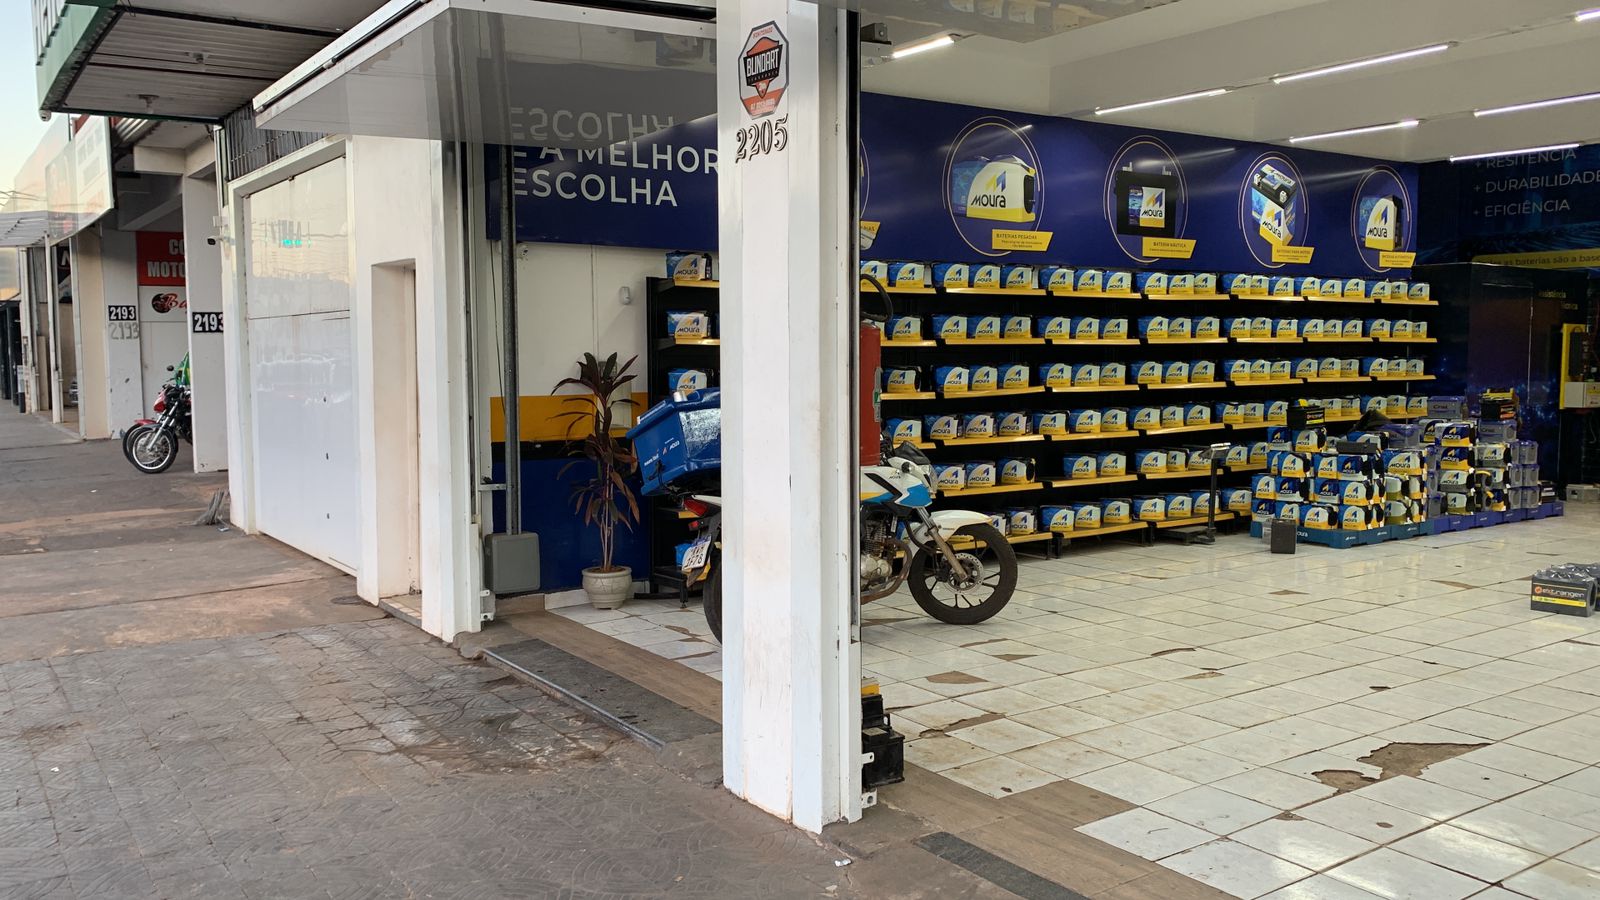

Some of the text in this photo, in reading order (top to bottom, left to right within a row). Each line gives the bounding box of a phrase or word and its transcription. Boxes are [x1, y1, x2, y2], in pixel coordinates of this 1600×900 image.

[746, 48, 780, 77] BLINDART
[735, 113, 788, 163] 2205
[514, 167, 678, 207] ESCOLHA
[1516, 256, 1550, 265] baterias
[110, 306, 136, 320] 2193
[194, 314, 224, 332] 2193
